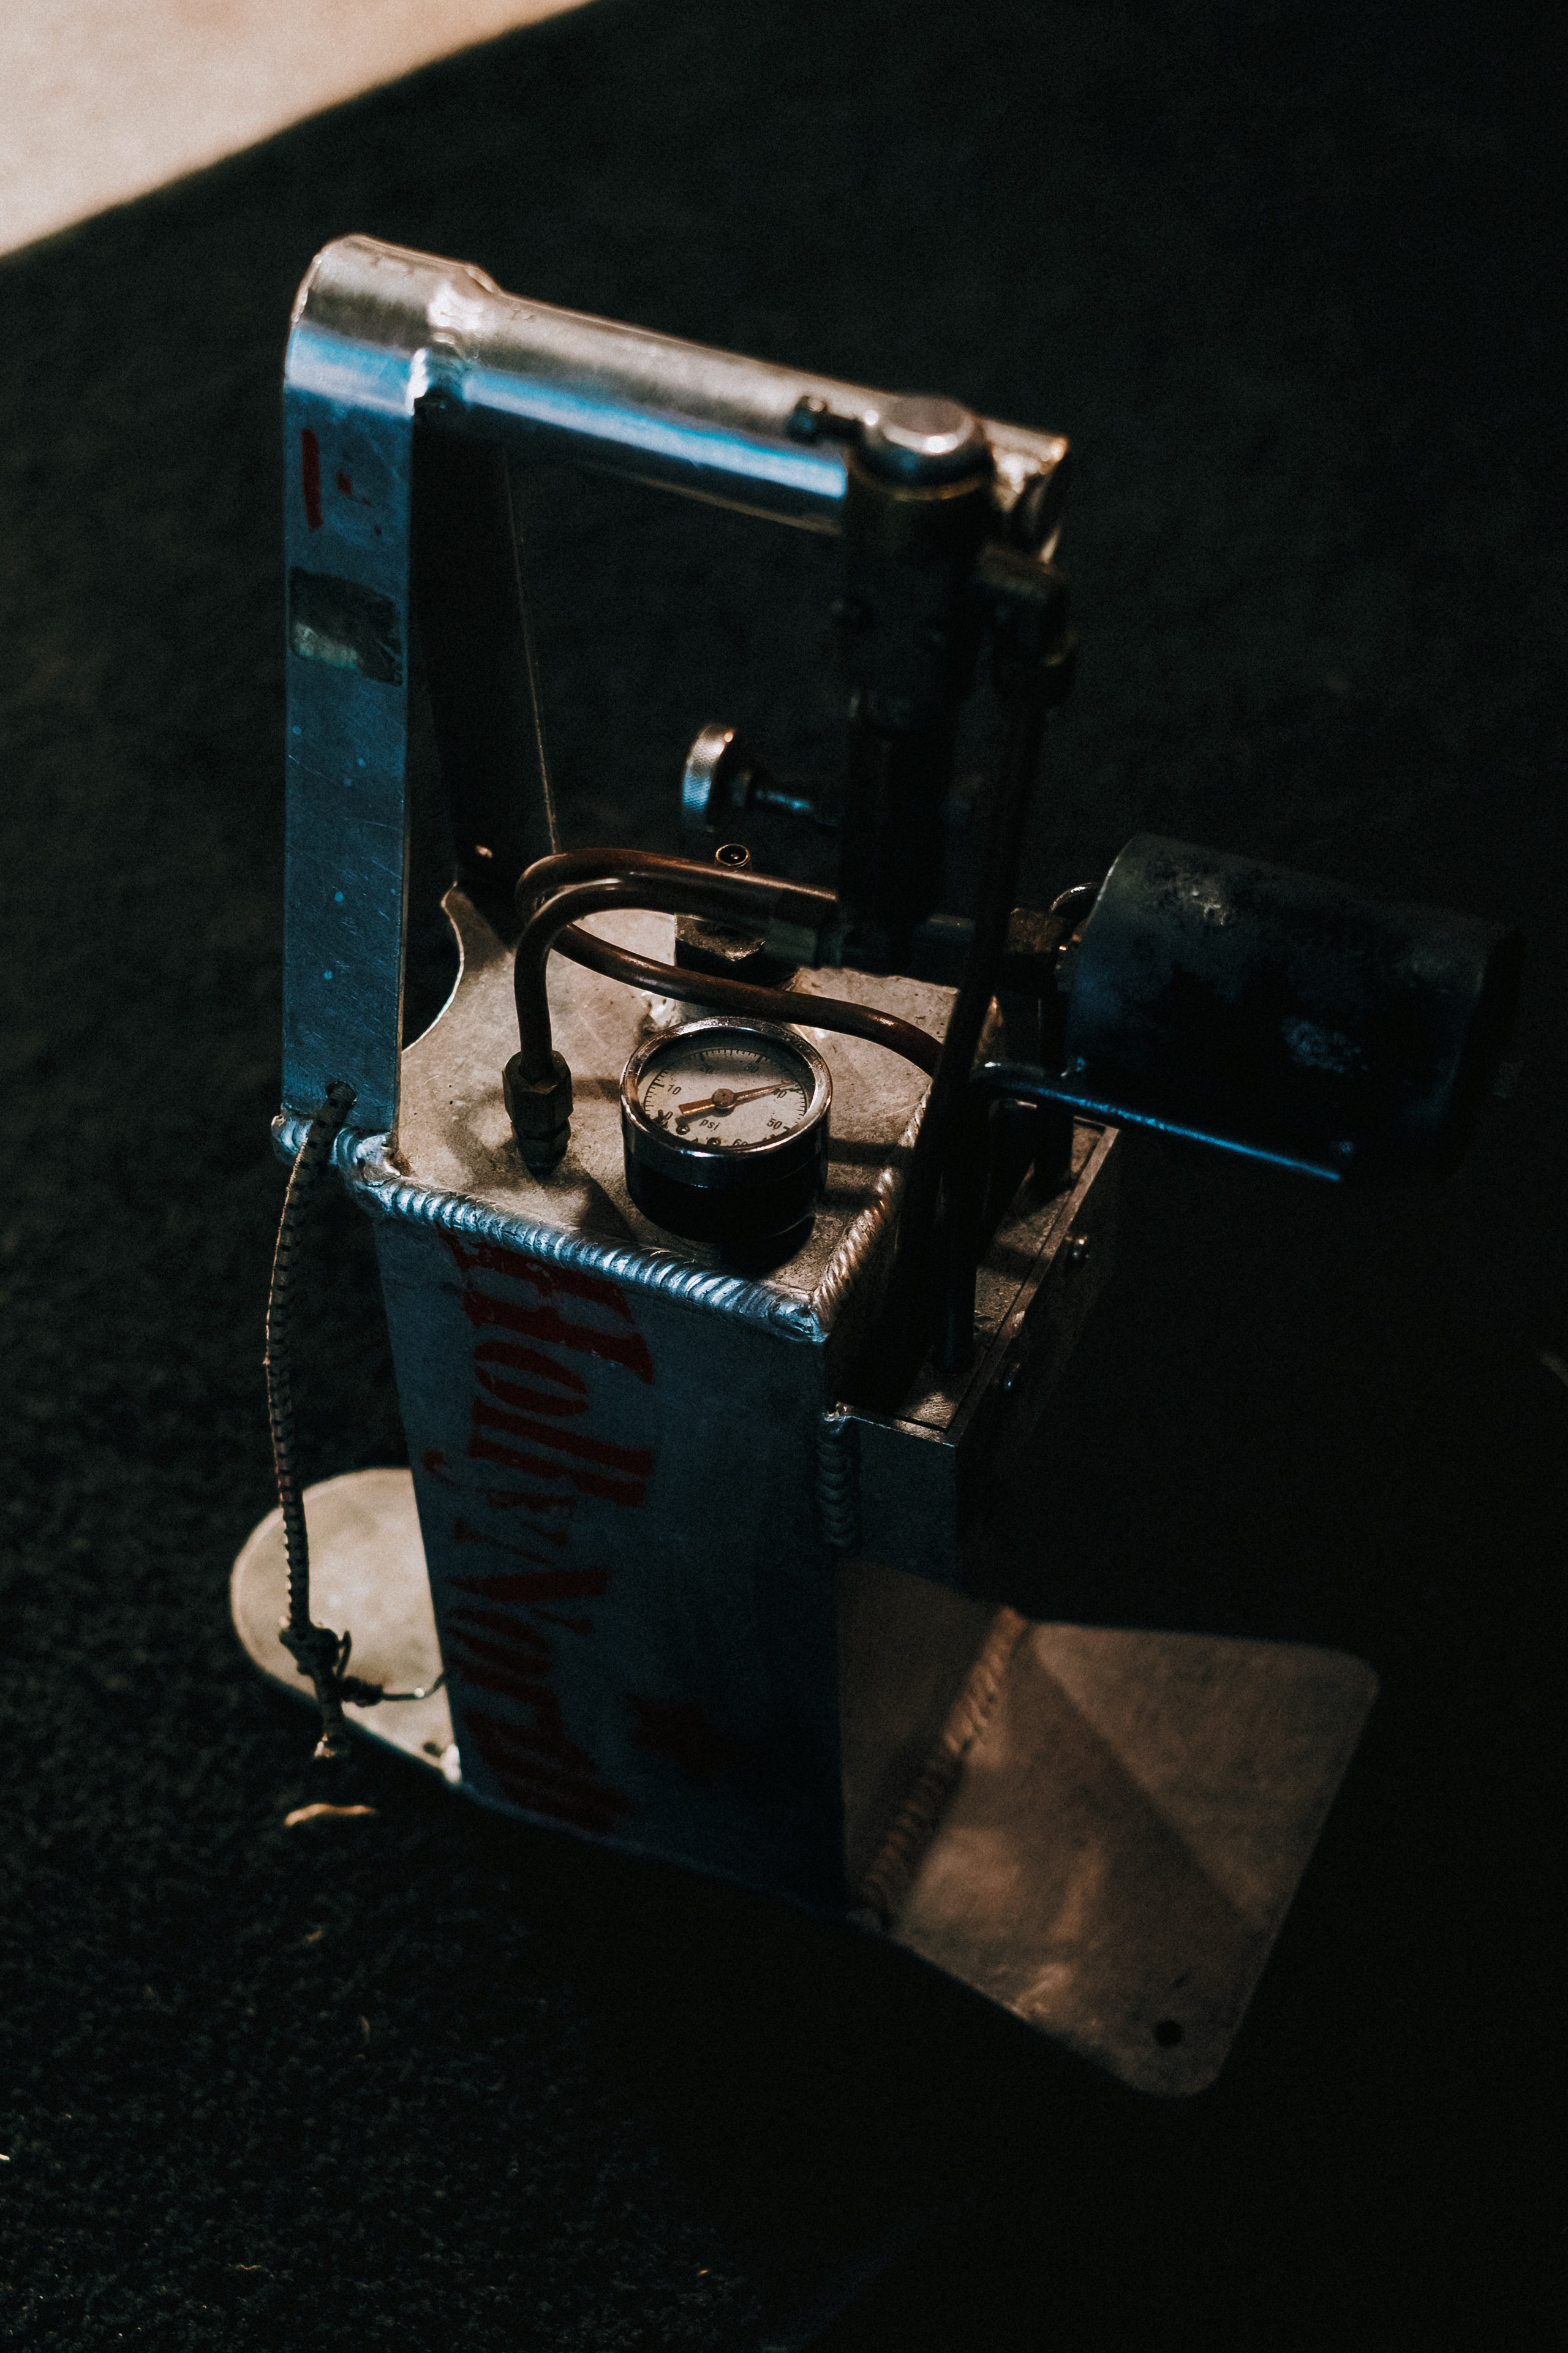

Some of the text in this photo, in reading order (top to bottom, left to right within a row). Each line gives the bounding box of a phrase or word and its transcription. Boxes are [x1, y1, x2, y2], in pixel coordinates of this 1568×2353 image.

[668, 1084, 682, 1095] 10
[699, 1119, 721, 1131] psi
[766, 1120, 783, 1130] 50
